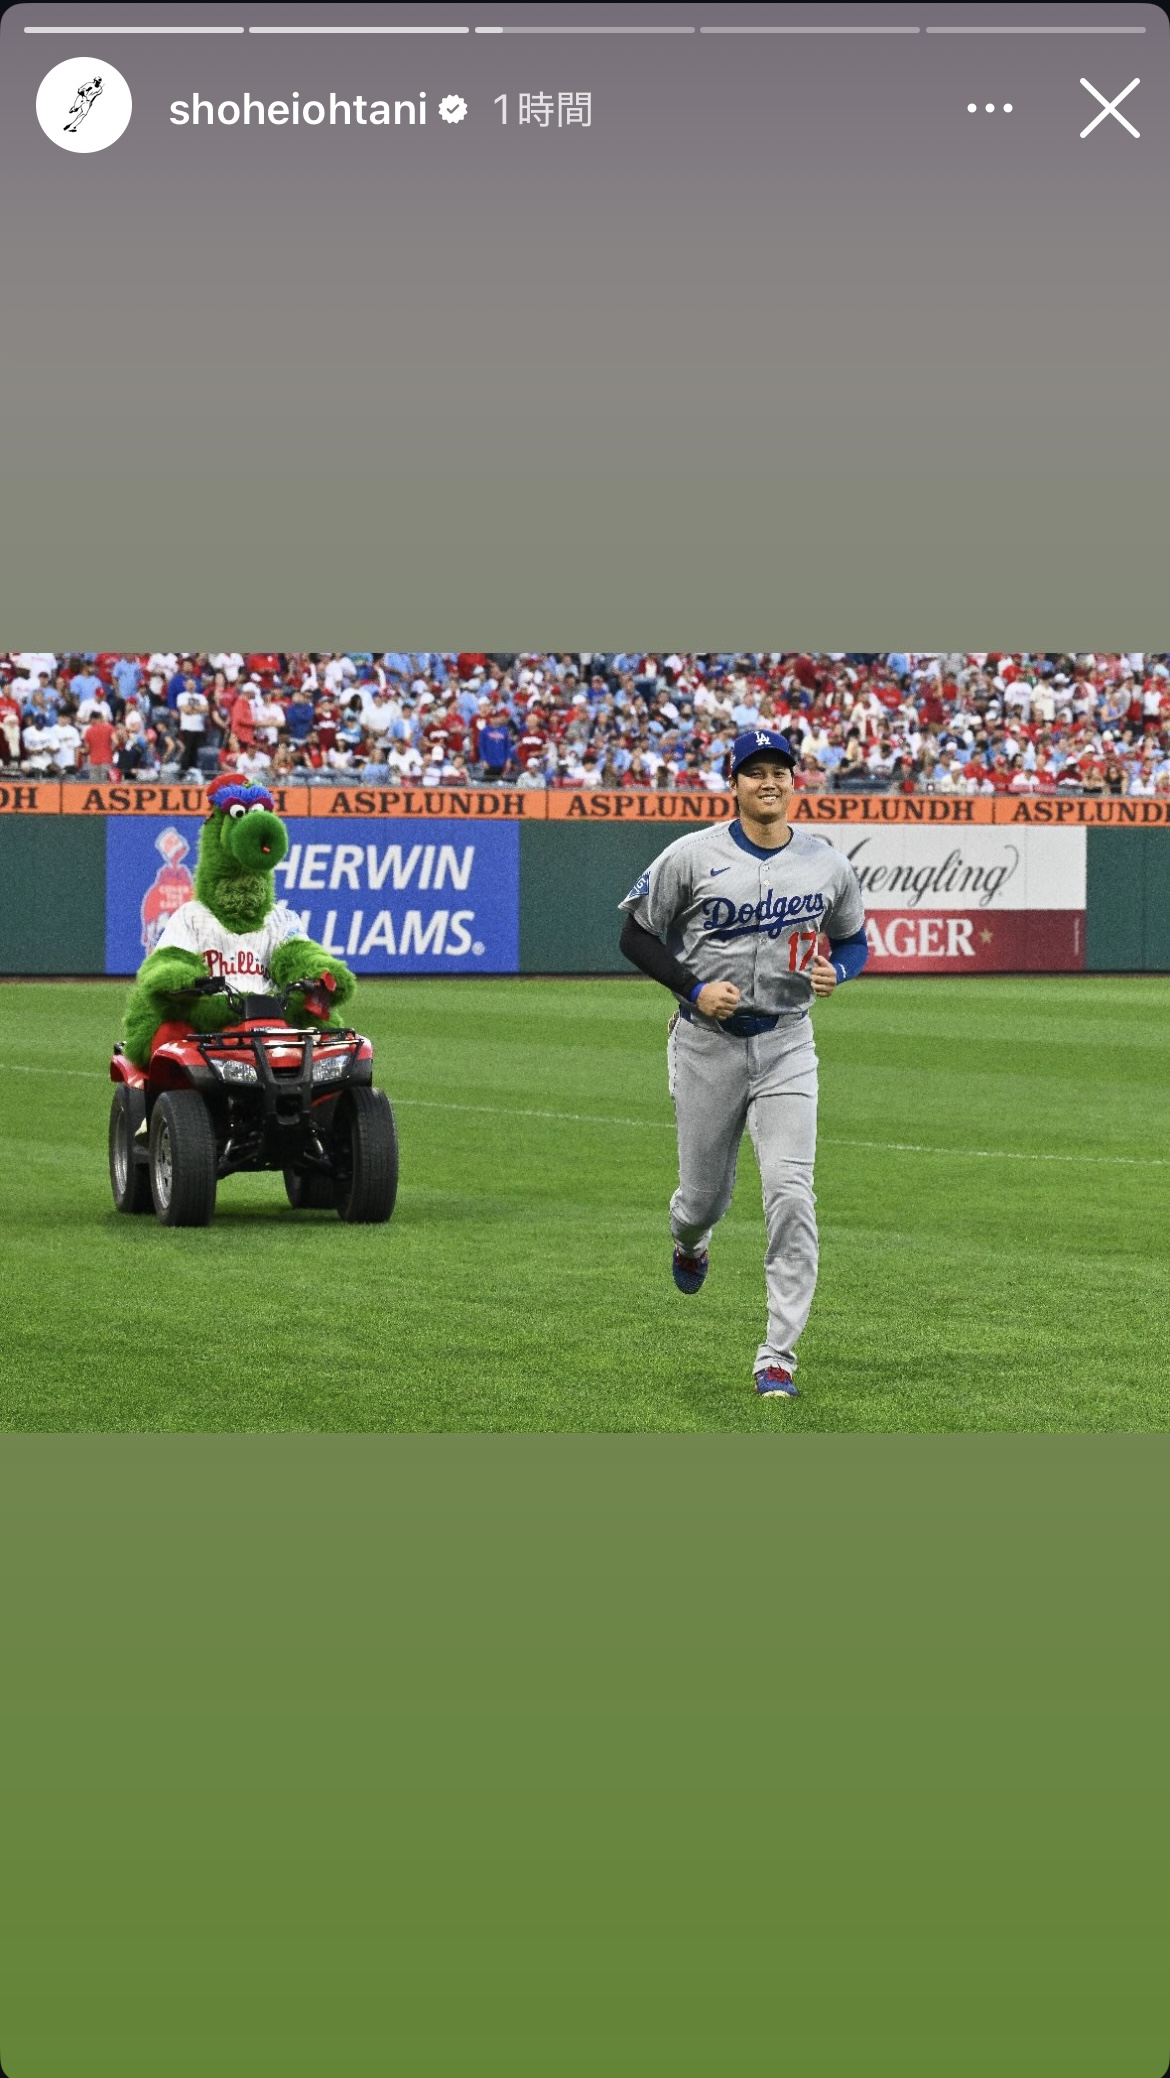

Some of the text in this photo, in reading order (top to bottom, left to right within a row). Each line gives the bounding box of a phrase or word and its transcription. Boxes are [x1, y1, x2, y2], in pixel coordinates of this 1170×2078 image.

[82, 788, 287, 812] ASPLUH
[330, 790, 526, 815] ASPLUNDH
[793, 798, 975, 821] ASPLUNDH
[1012, 800, 1170, 822] ASPLUND
[276, 844, 475, 890] HERWIN
[703, 888, 824, 939] Dodgers
[787, 931, 817, 971] 17
[866, 917, 976, 957] AGER
